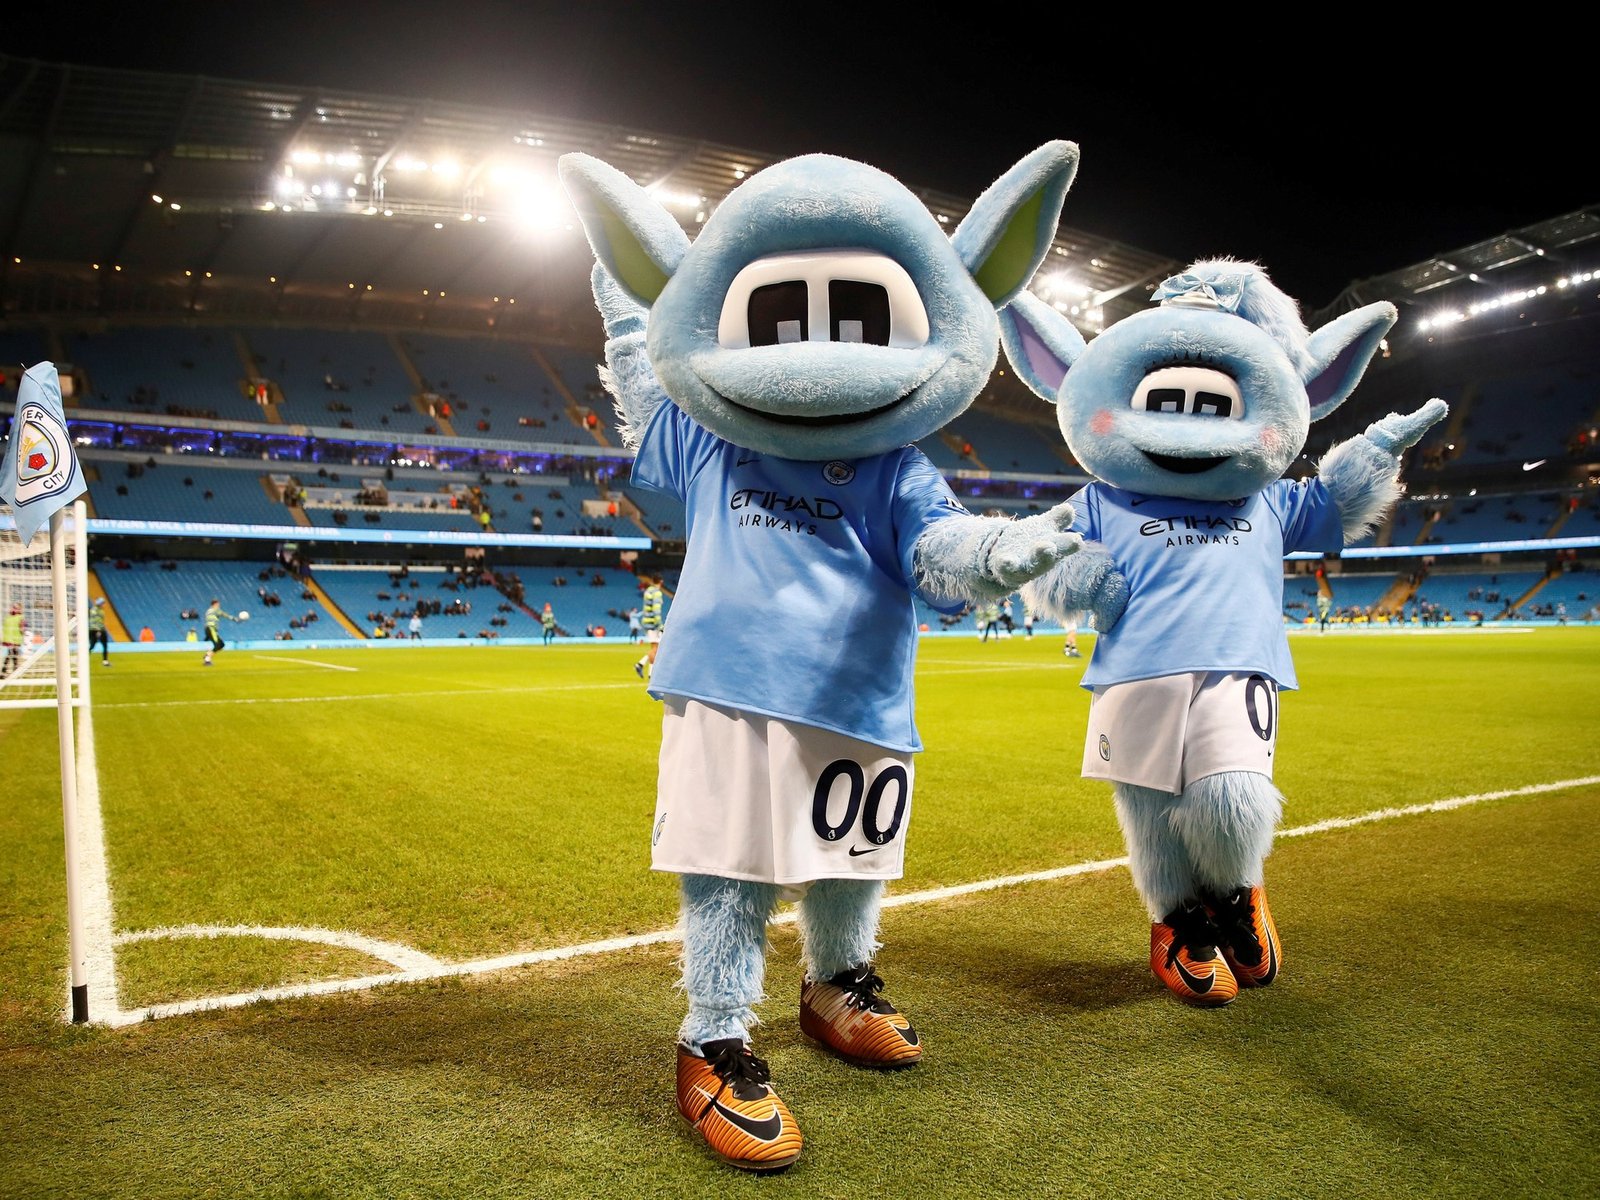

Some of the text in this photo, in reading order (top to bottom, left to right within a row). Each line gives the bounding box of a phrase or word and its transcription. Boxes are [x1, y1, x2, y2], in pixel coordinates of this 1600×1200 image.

[43, 470, 65, 490] CITY
[730, 488, 844, 520] ETIHAD
[738, 514, 817, 535] AIRWAYS
[1139, 515, 1253, 537] ETIHAD
[1166, 534, 1240, 548] AIRWAYS
[812, 758, 908, 846] 00
